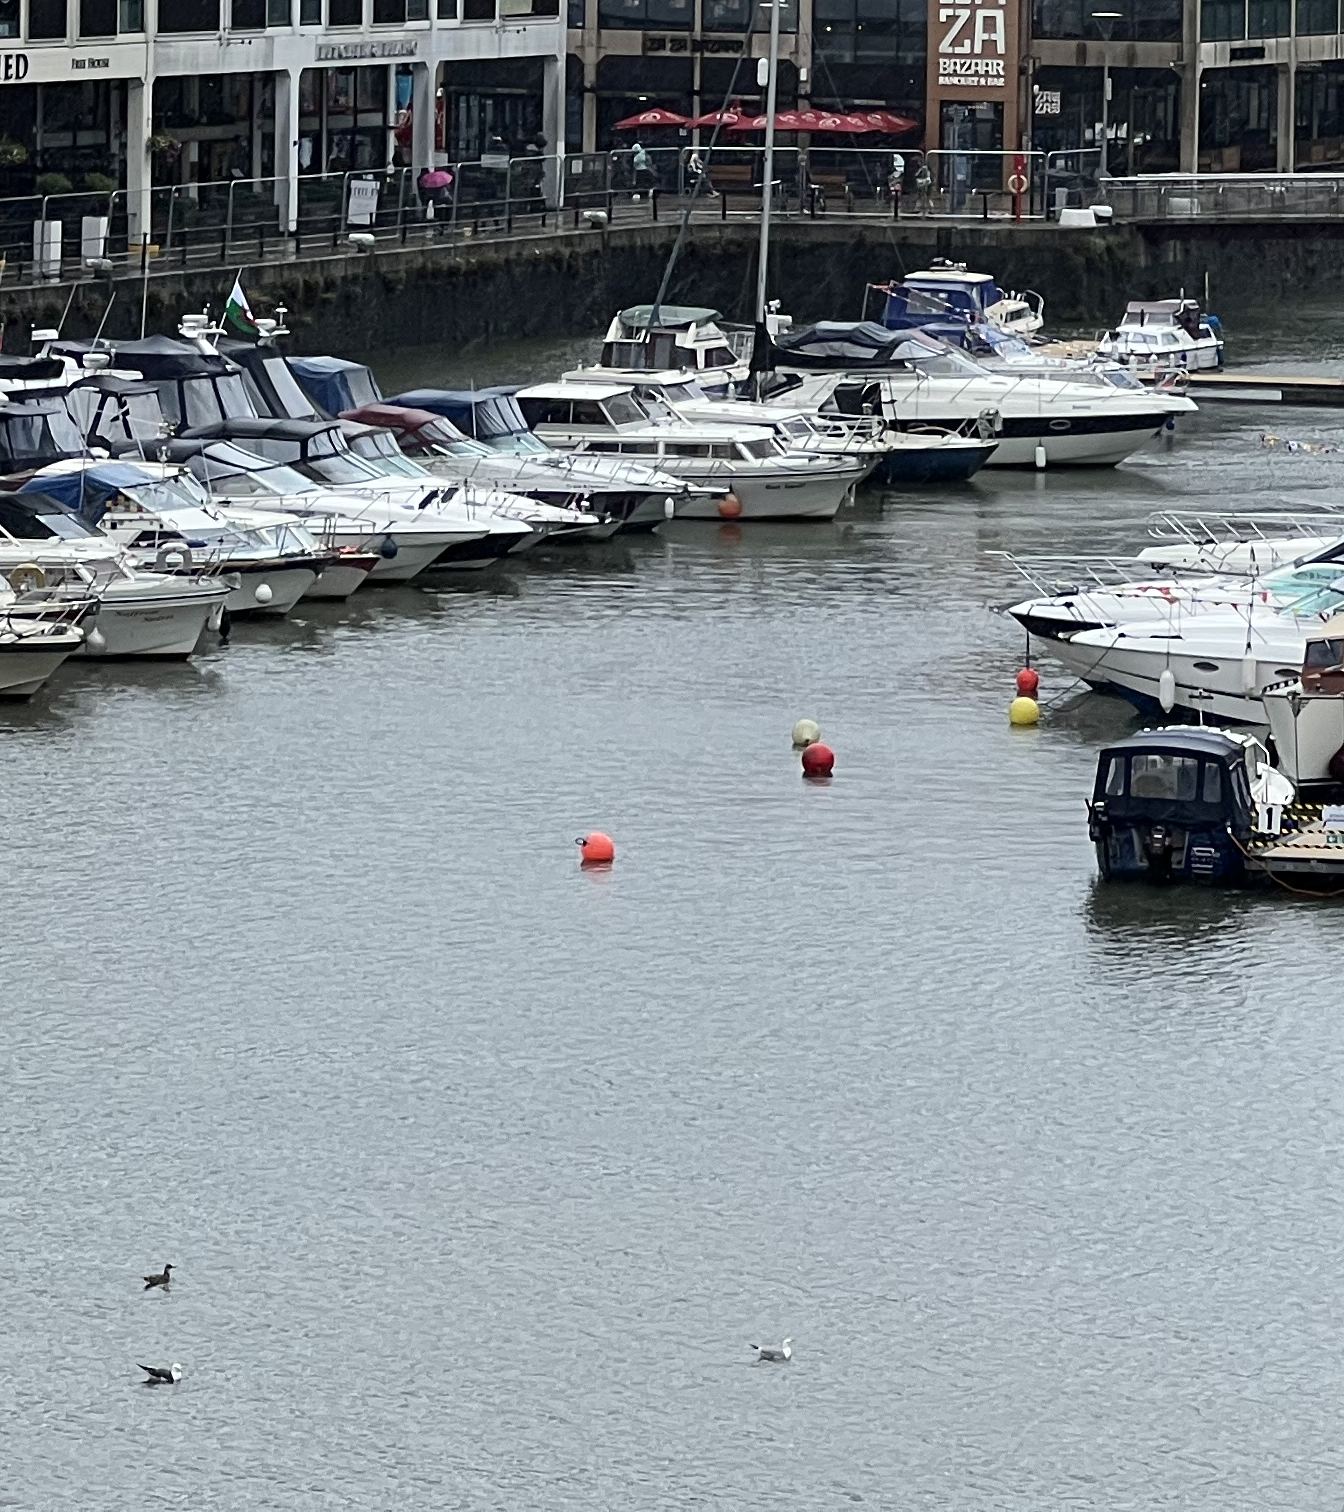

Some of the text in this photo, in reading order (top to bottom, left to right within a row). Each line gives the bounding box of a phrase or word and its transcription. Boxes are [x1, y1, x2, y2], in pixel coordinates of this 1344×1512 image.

[938, 8, 1006, 55] ZA
[938, 58, 1005, 76] BAZAAR
[1266, 806, 1274, 831] 1
